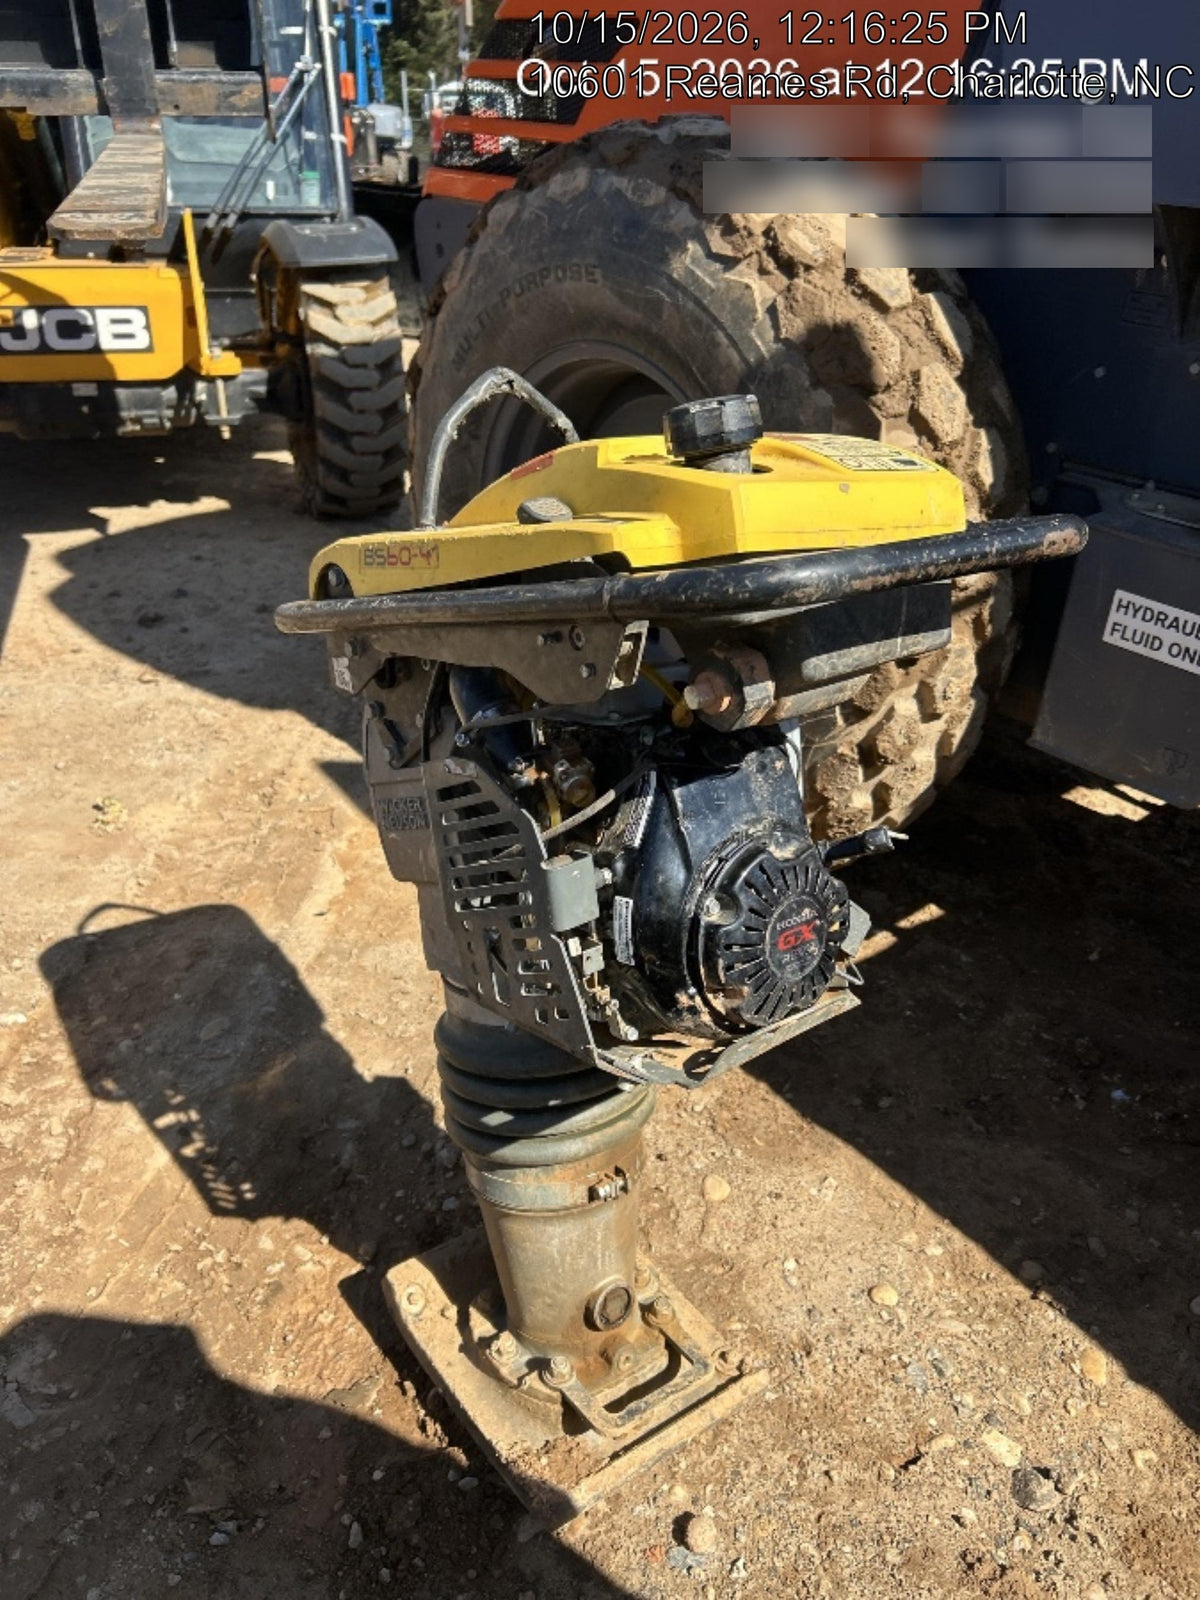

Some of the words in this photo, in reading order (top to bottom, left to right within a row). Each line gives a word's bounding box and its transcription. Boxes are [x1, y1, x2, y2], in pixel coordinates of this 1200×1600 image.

[0, 308, 150, 351] JCB
[1110, 622, 1163, 651] FLUID
[777, 921, 816, 952] GX
